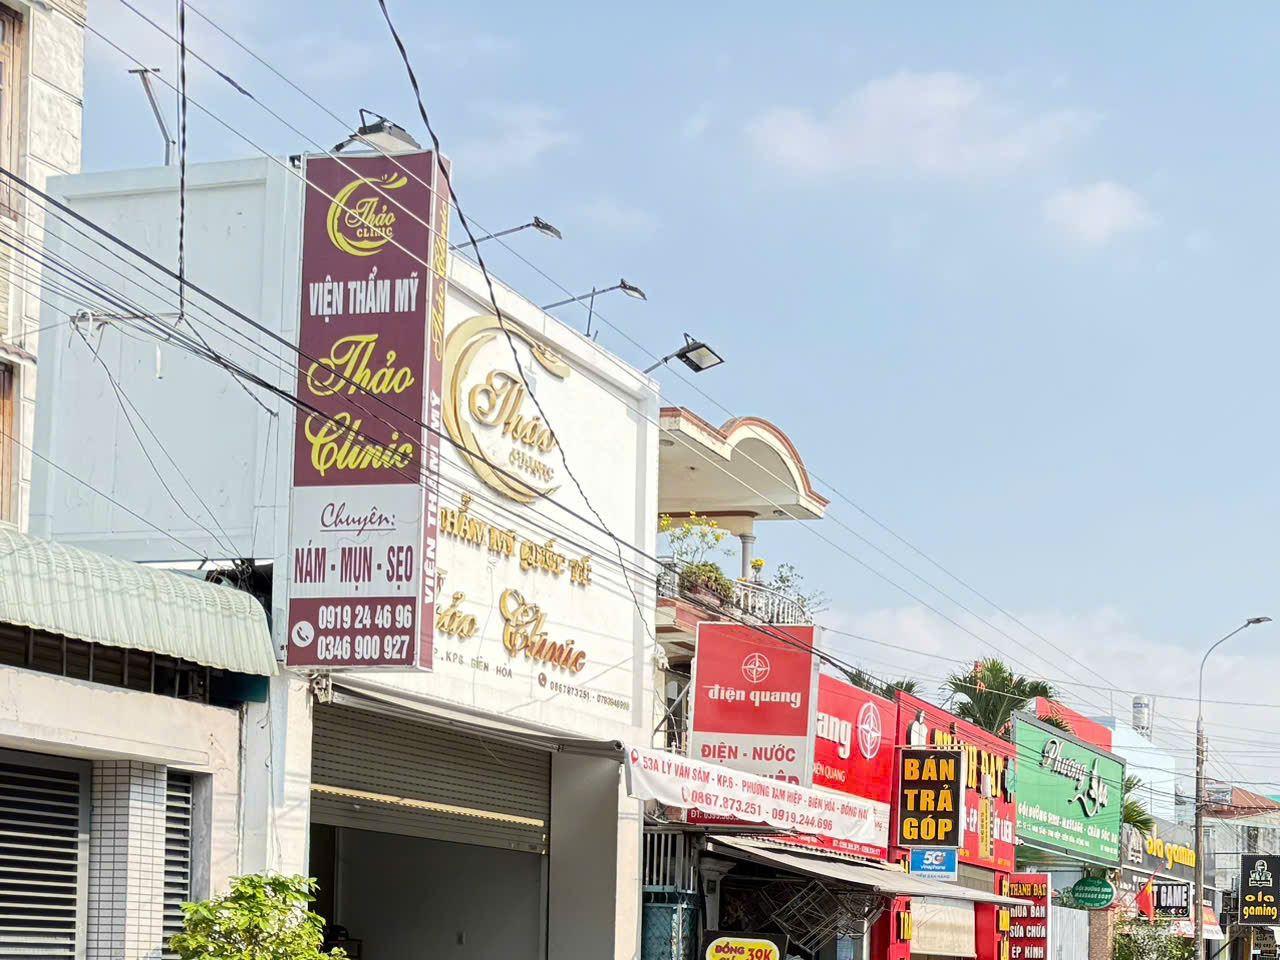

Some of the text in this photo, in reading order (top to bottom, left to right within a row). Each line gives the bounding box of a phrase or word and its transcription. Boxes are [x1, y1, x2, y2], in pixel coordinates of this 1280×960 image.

[345, 197, 396, 228] Thảo
[356, 227, 393, 238] CLINIC
[309, 266, 419, 323] VIỆN THẨM MỸ
[306, 333, 415, 396] Thảo
[304, 411, 414, 477] Clinic
[294, 540, 413, 590] NÁM MỤN SẸO
[318, 604, 413, 629] 0919 24 46 96
[317, 635, 410, 660] 0346 900 927
[702, 684, 801, 708] điện quang
[816, 712, 852, 759] ang
[701, 742, 796, 762] ĐIỆN NƯỚC
[643, 756, 659, 772] 53A
[661, 760, 672, 776] LÝ
[904, 755, 955, 780] BÁN
[691, 790, 832, 830] 0867.873.251 0919.244.696
[904, 784, 953, 811] TRẢ
[903, 815, 953, 840] GÓP
[1165, 842, 1196, 870] gamin
[1160, 885, 1187, 907] GAME
[1245, 891, 1275, 902] ola
[1243, 904, 1277, 920] gaming
